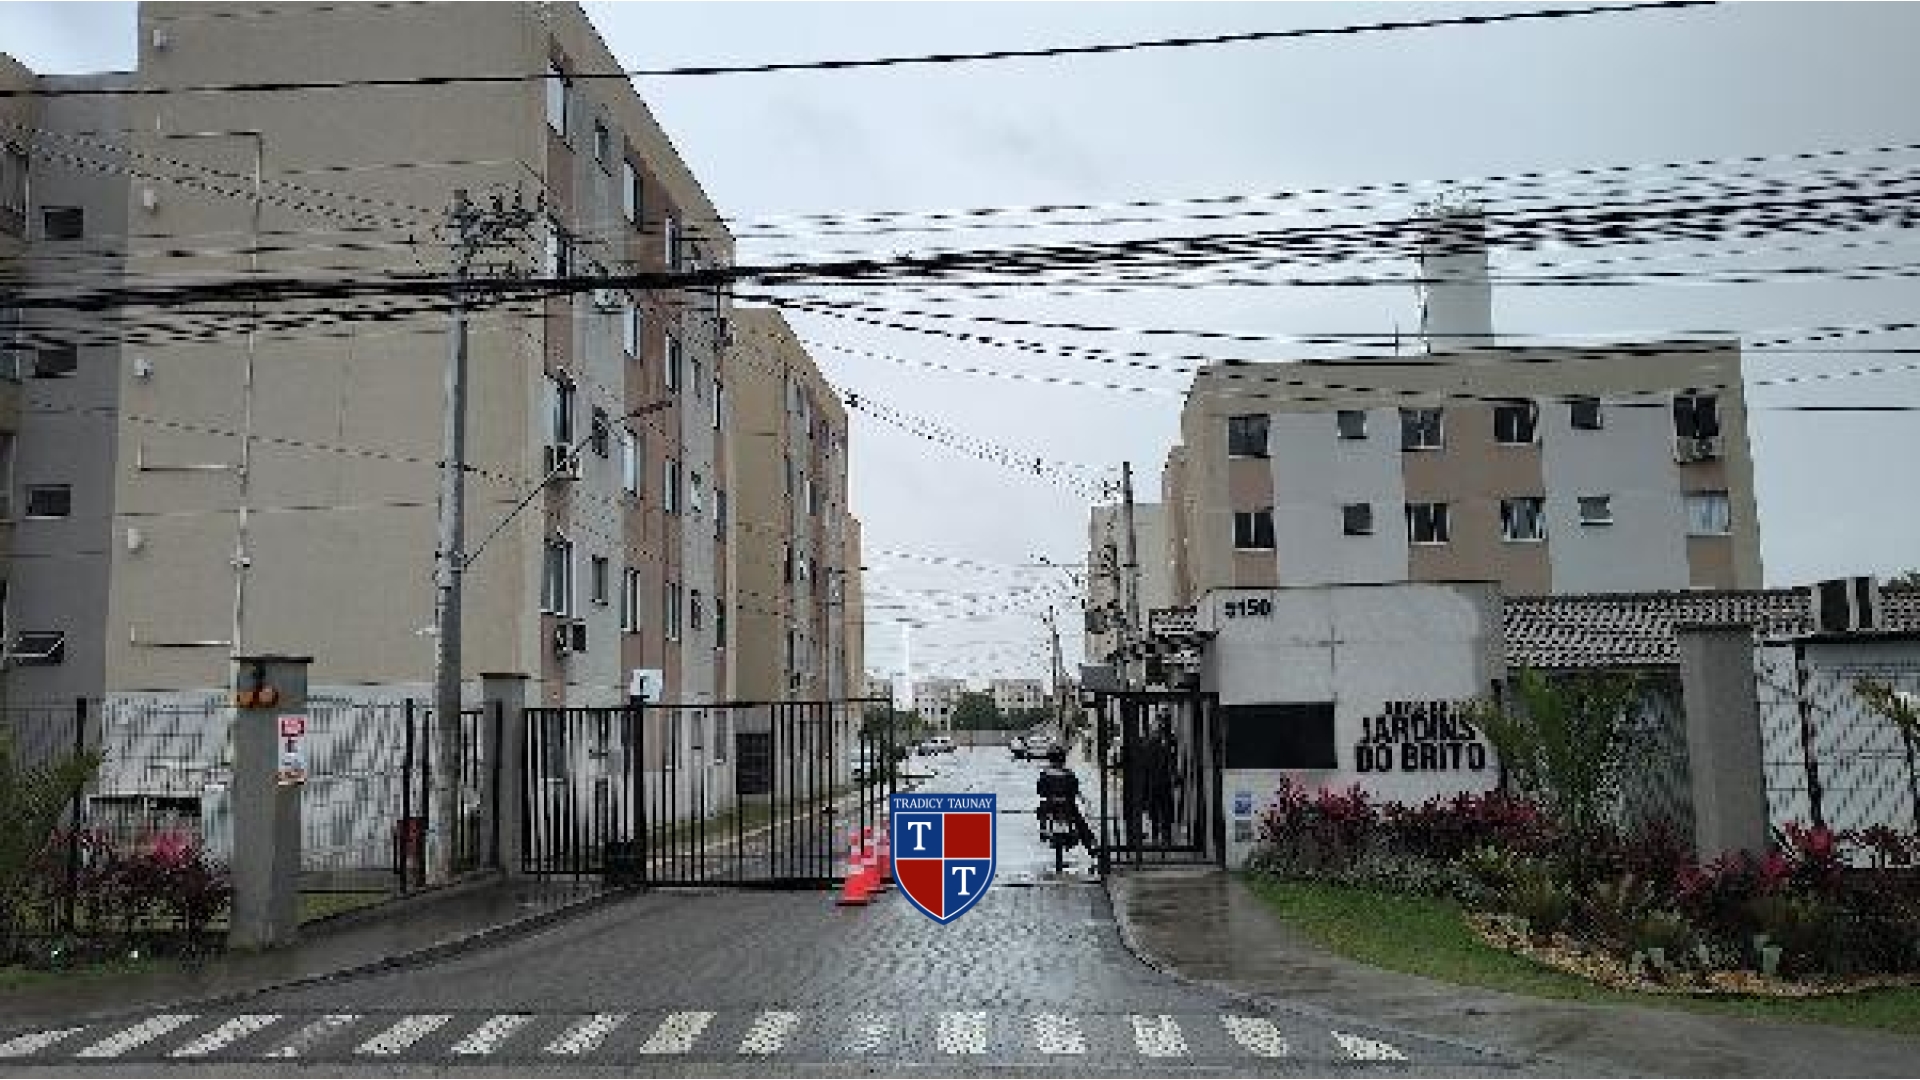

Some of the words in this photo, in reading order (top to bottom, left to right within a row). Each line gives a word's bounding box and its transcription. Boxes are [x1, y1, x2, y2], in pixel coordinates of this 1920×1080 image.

[1360, 714, 1476, 743] JARDINS
[1356, 743, 1393, 772] DO
[1401, 742, 1485, 770] BRITO
